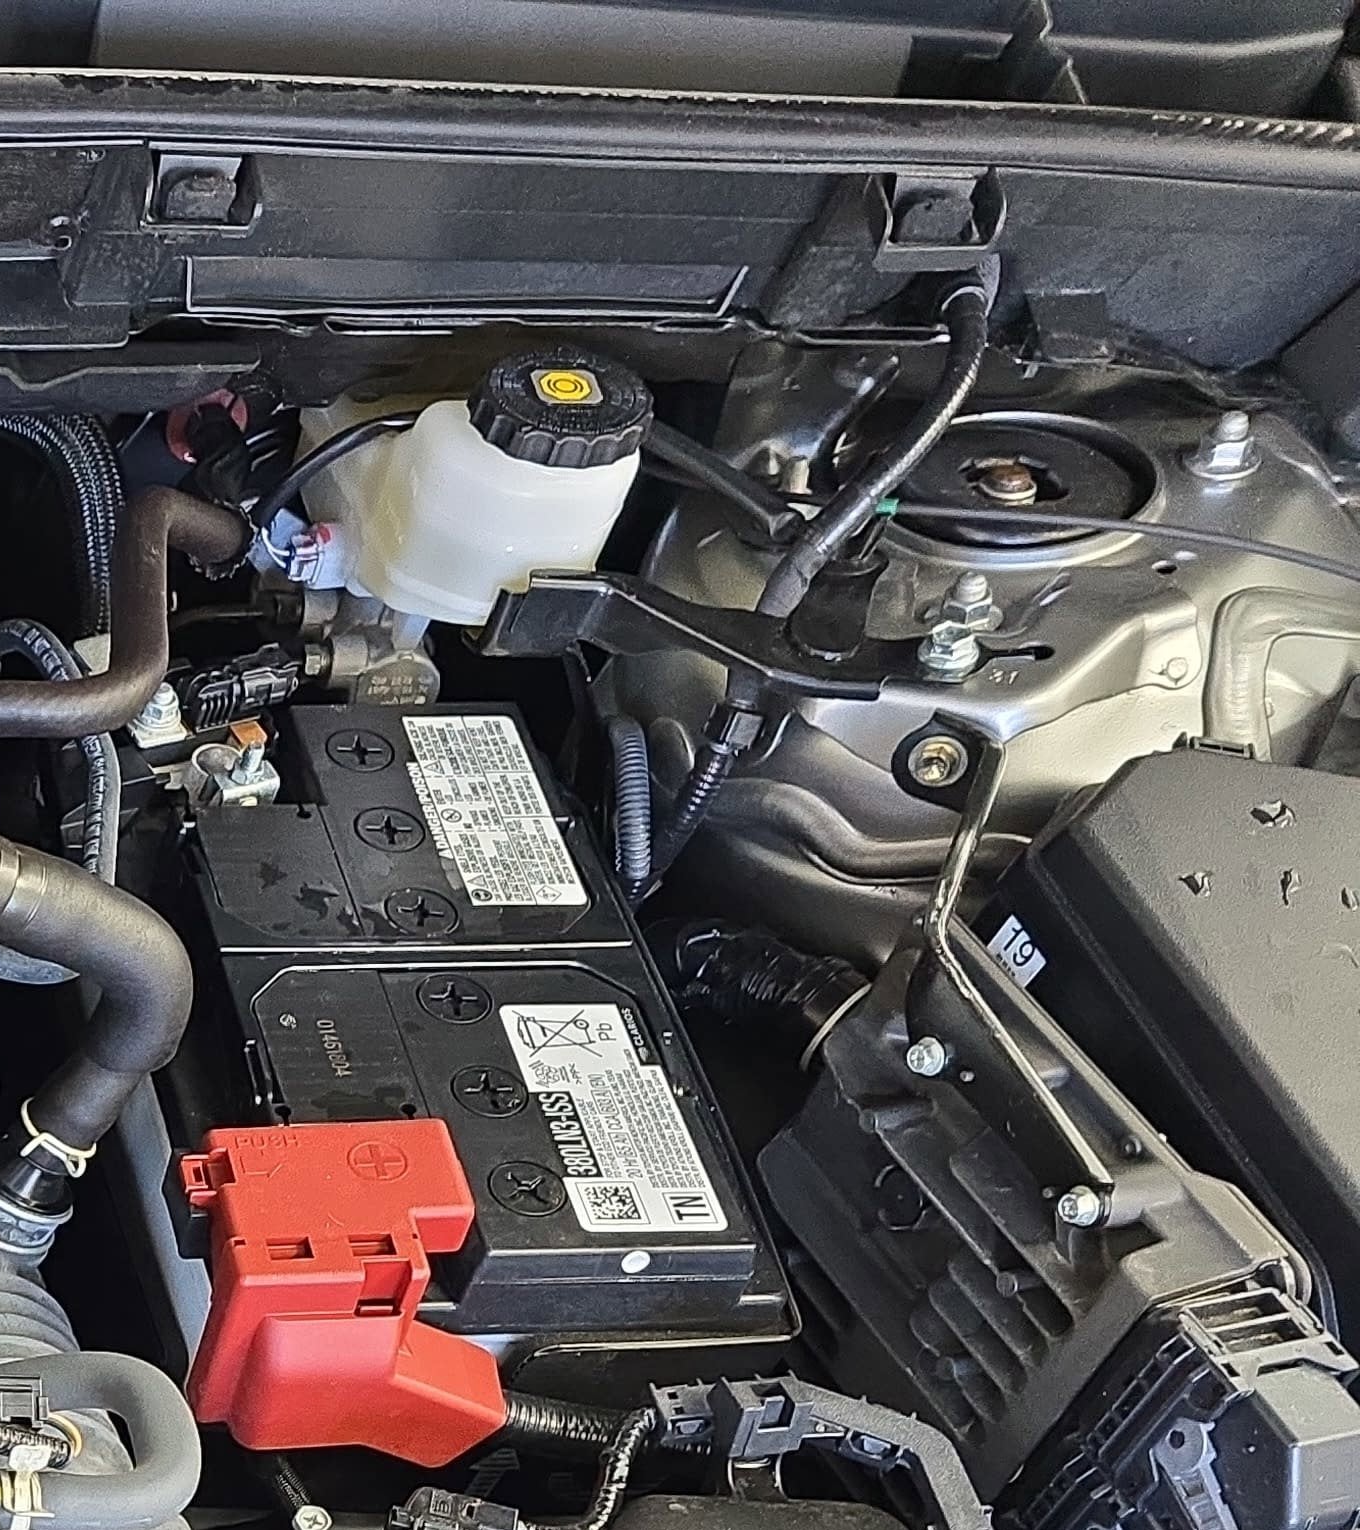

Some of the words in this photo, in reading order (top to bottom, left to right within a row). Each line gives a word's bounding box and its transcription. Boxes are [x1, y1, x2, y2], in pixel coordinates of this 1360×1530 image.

[406, 762, 450, 849] DANGER/POISON
[1003, 927, 1035, 967] 19
[597, 1022, 614, 1042] Pb
[621, 1007, 645, 1046] CLARIOS
[234, 1134, 300, 1149] PUSH
[538, 1093, 598, 1176] 380LN3-ISS
[669, 1196, 711, 1220] TN
